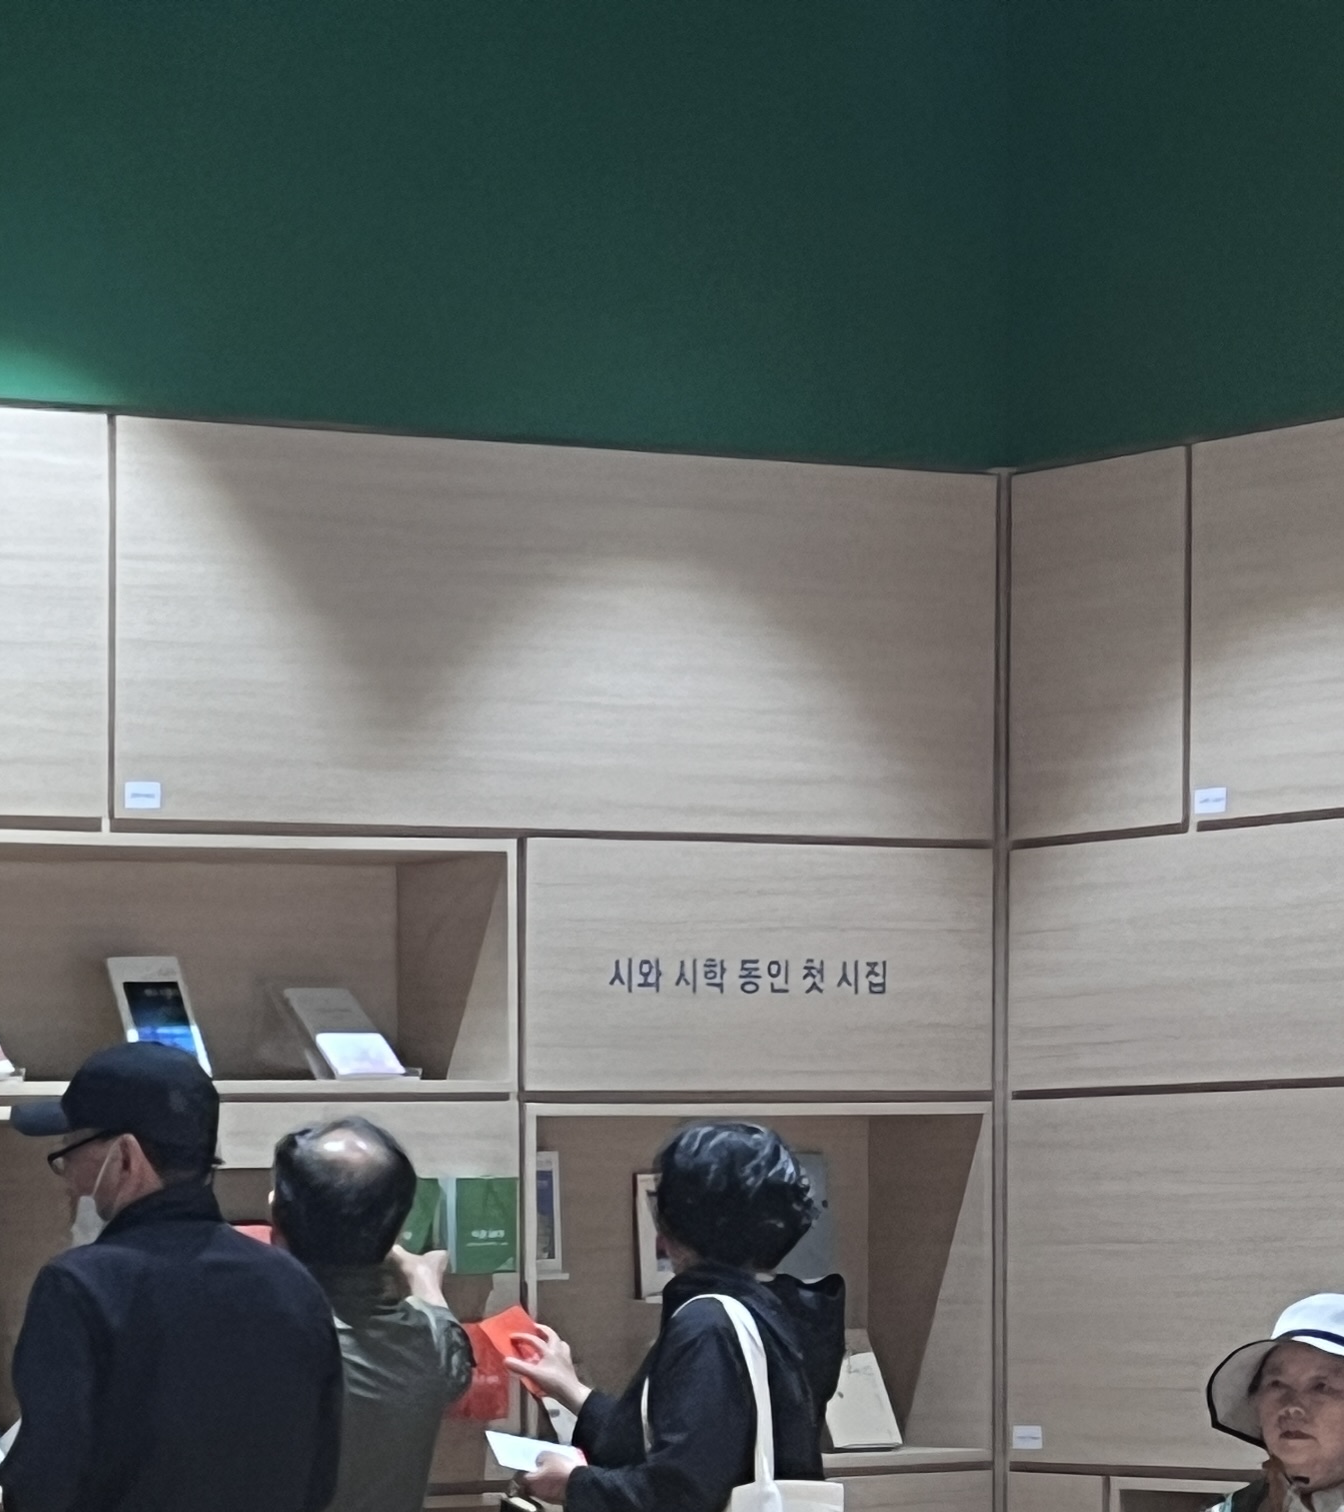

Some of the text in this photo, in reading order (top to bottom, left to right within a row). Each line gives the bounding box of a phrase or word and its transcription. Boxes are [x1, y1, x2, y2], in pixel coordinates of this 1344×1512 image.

[609, 957, 887, 995] 시와 시학 동인 첫 시집
